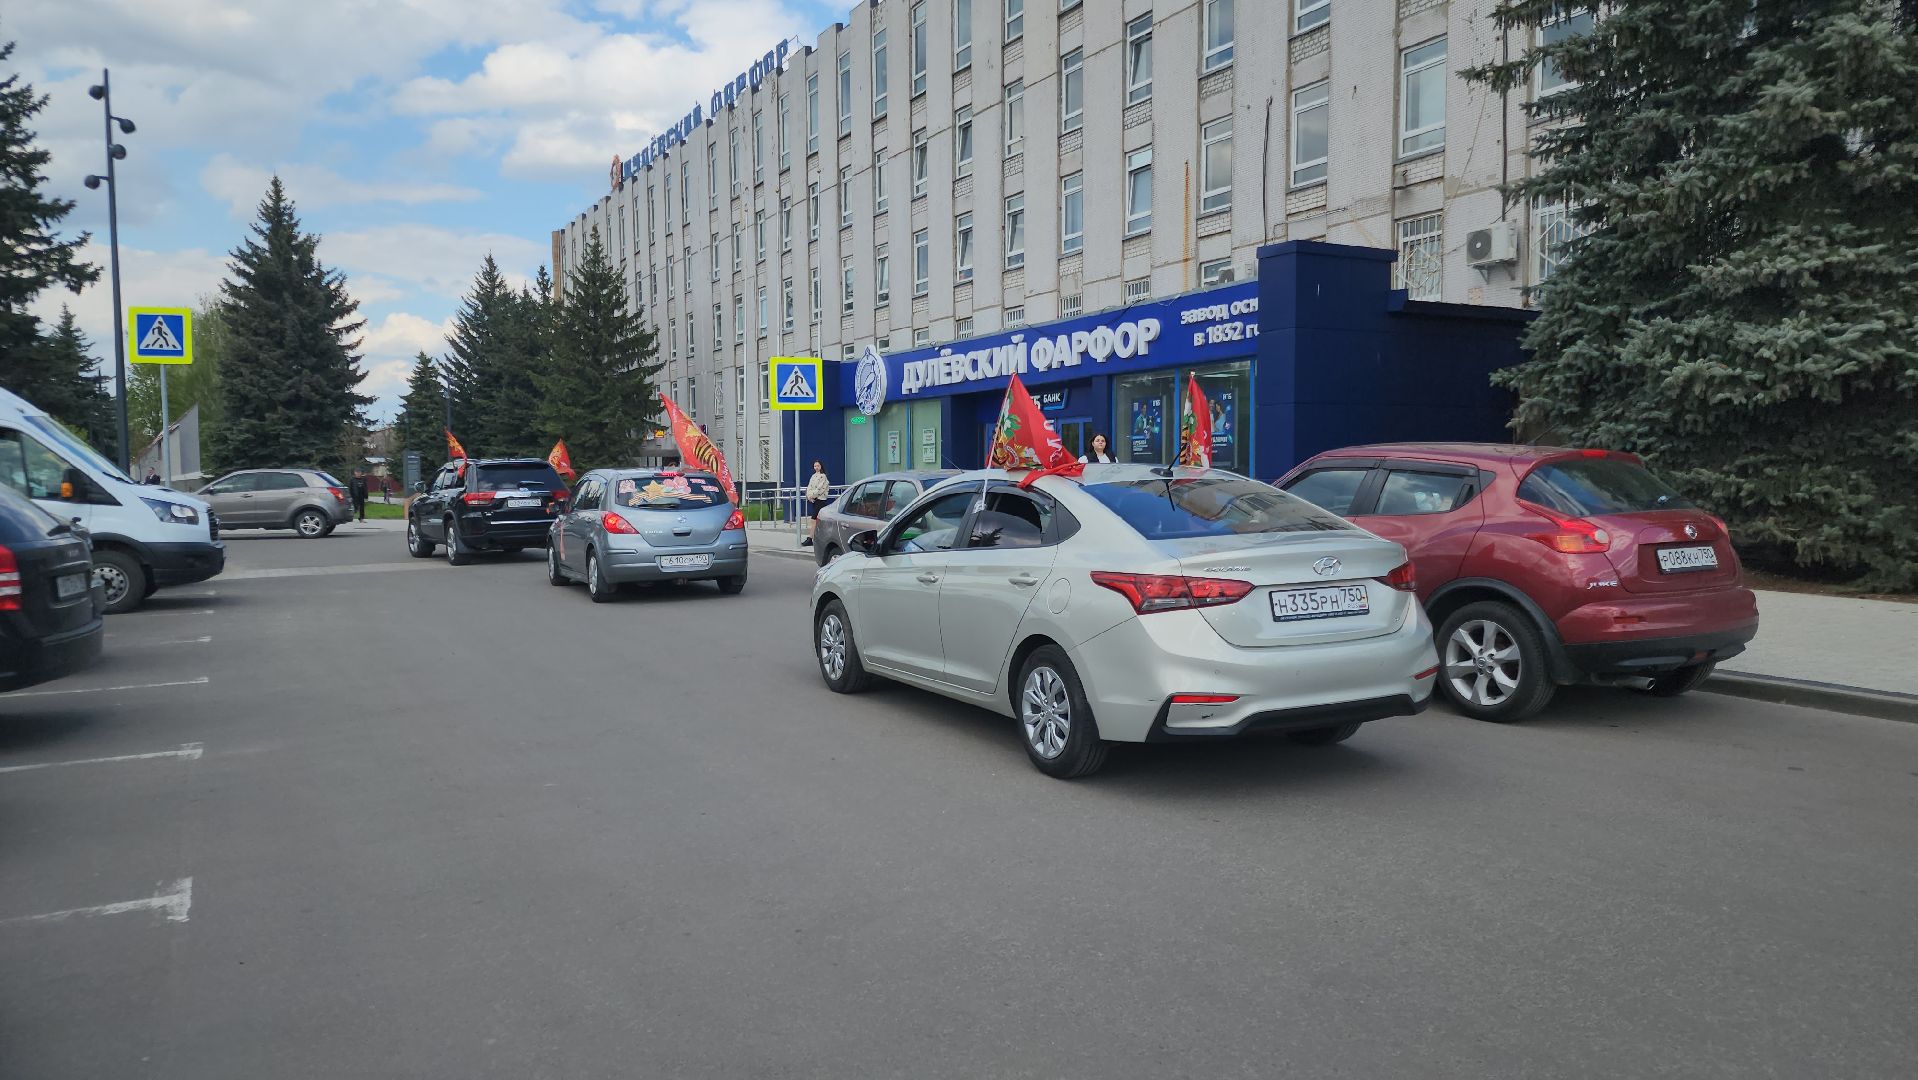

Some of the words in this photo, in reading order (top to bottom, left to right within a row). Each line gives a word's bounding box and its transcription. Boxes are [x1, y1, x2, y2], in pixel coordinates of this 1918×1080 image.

[710, 38, 788, 118] ФАРФОР
[1180, 304, 1229, 325] завод
[1193, 332, 1206, 346] в
[1206, 321, 1245, 344] 1832
[901, 333, 1028, 395] ДУЛЁВСКИЙ
[1030, 318, 1160, 372] ФАРФОР
[1043, 392, 1061, 404] БАНК
[1277, 592, 1340, 614] Н335РН
[1340, 587, 1362, 603] 750
